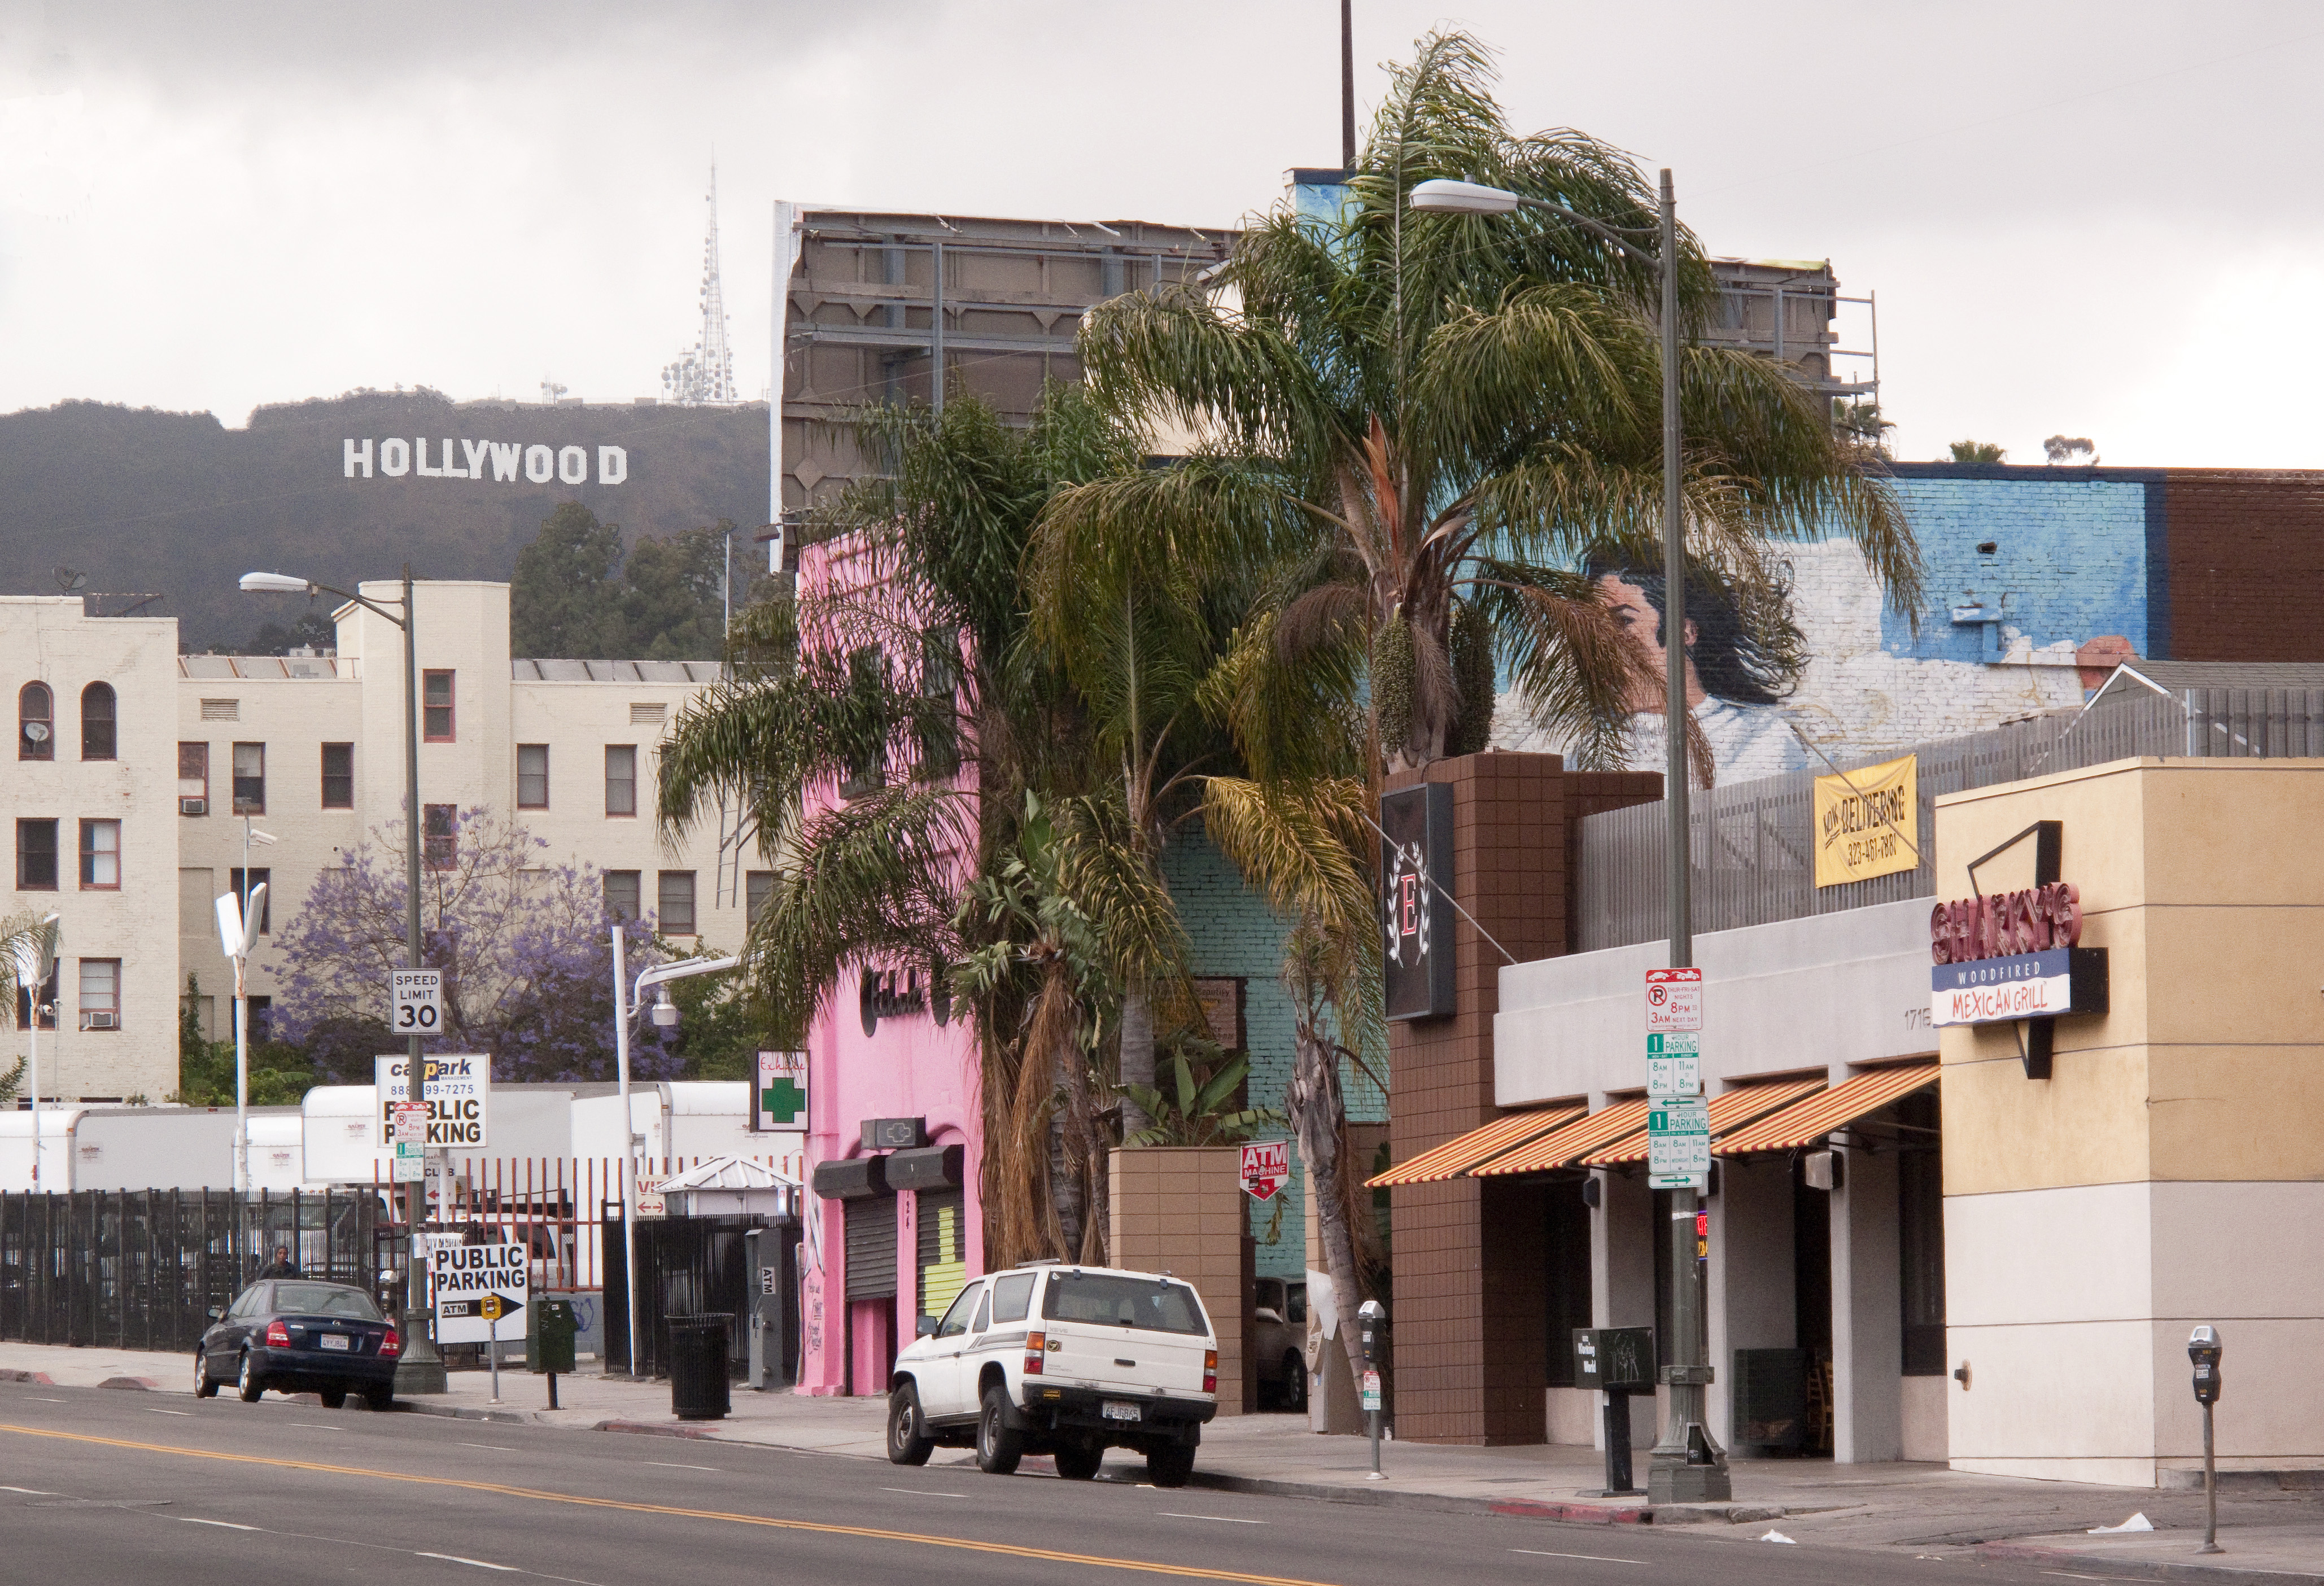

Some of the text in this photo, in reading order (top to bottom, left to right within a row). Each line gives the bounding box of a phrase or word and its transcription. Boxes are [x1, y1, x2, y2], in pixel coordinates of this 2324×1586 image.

[344, 438, 627, 484] HOLLYWOOD
[1823, 785, 1906, 837] NOW DELIVERING
[1401, 873, 1418, 937] E
[1958, 961, 2041, 985] WOODFIRED
[396, 976, 438, 986] SPEED
[400, 990, 434, 1000] LIMIT
[1671, 1002, 1690, 1013] 8PM
[1952, 985, 2048, 1020] MEXICAN GRILL
[399, 1005, 437, 1028] 30
[1651, 1012, 1670, 1023] 3AM
[1654, 1036, 1658, 1051] 1
[1666, 1041, 1696, 1052] PARKING
[391, 1059, 472, 1080] capark
[1653, 1062, 1667, 1071] 8AM
[1679, 1061, 1694, 1071] 11AM
[1653, 1080, 1667, 1089] 8PM
[1679, 1078, 1694, 1089] 8PM
[384, 1099, 479, 1121] PBLIC
[1656, 1113, 1661, 1129] 1
[1670, 1118, 1706, 1130] PARKING
[385, 1122, 480, 1144] PKING
[1243, 1144, 1287, 1169] ATM
[425, 1168, 455, 1177] CLB
[637, 1181, 663, 1195] VI
[435, 1246, 523, 1270] PUBLIC
[436, 1269, 525, 1292] PARKING
[763, 1269, 772, 1294] ATM
[443, 1305, 467, 1314] ATM
[1578, 1343, 1595, 1357] Working
[1583, 1360, 1597, 1373] World
